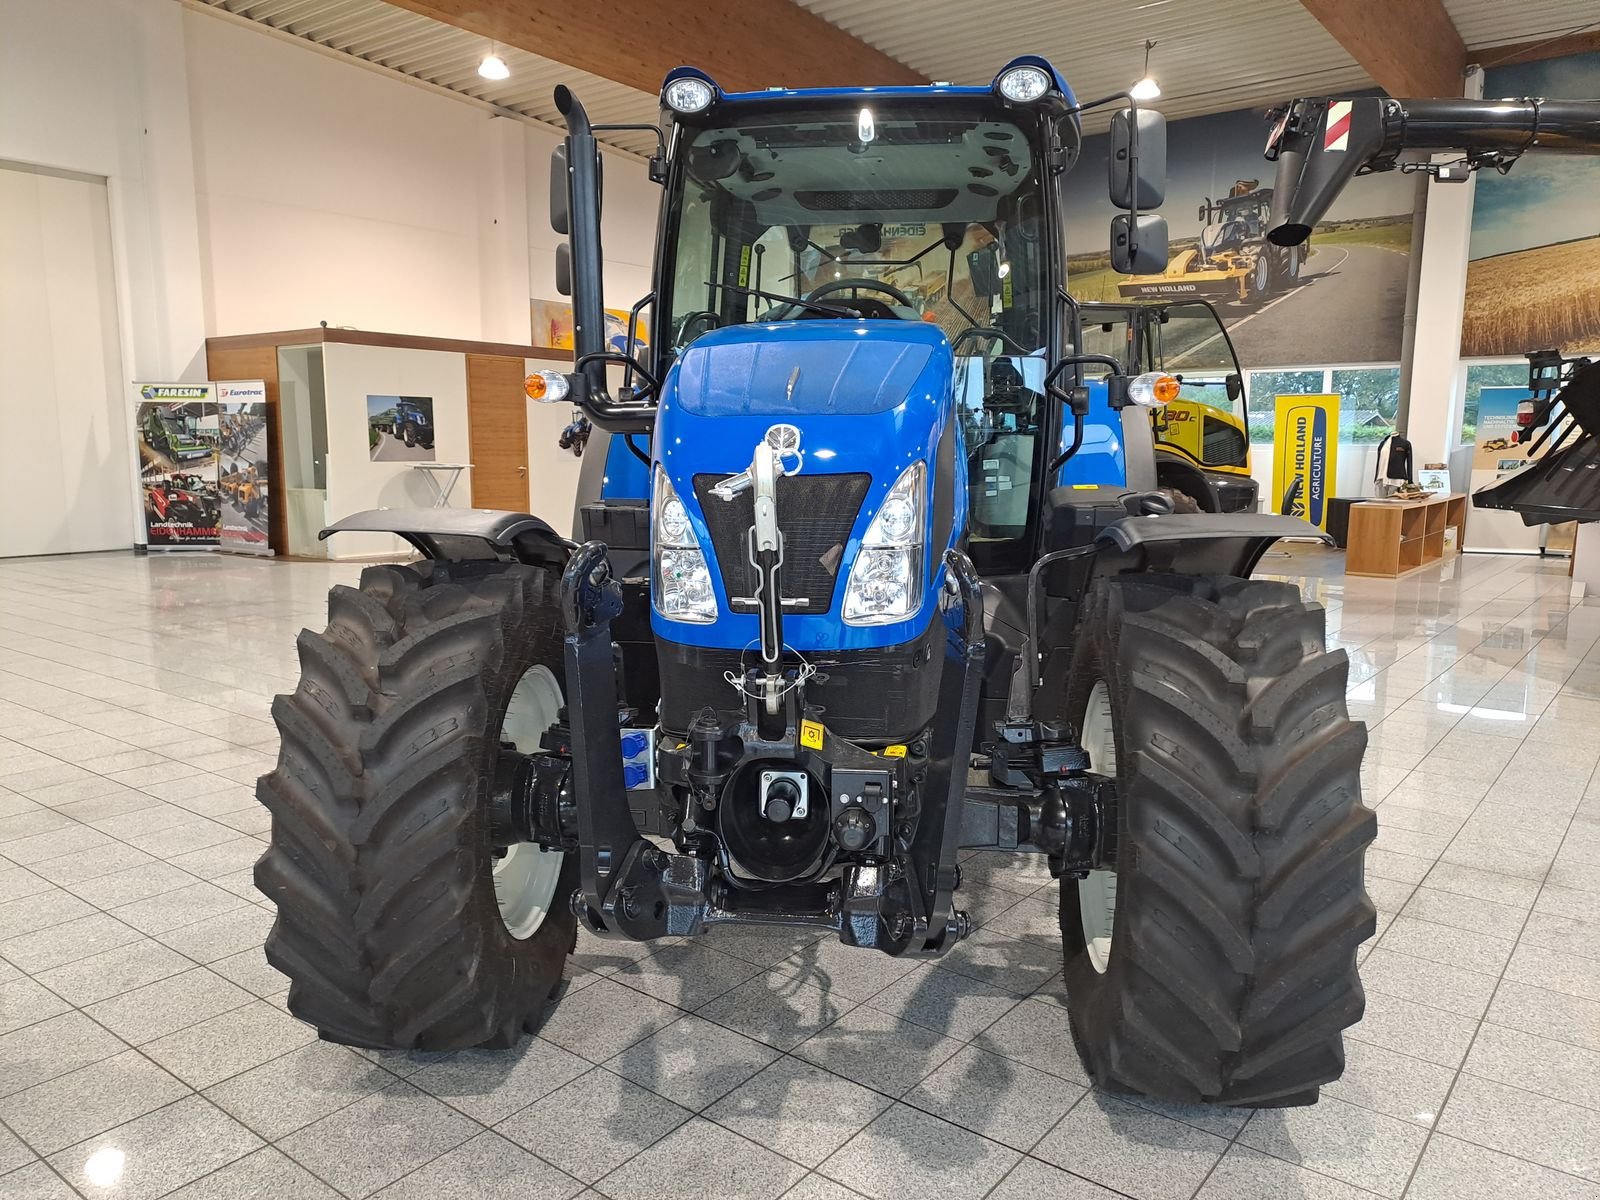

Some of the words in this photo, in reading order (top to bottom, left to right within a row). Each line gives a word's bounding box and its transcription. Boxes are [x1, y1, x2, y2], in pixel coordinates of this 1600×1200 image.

[1141, 286, 1158, 294] NEW
[1158, 284, 1197, 293] HOLLAND
[157, 387, 202, 398] FARESIN
[229, 389, 263, 397] Eurotrac
[1295, 417, 1307, 471] HOLLAND
[1312, 436, 1322, 500] AGRICULTURE
